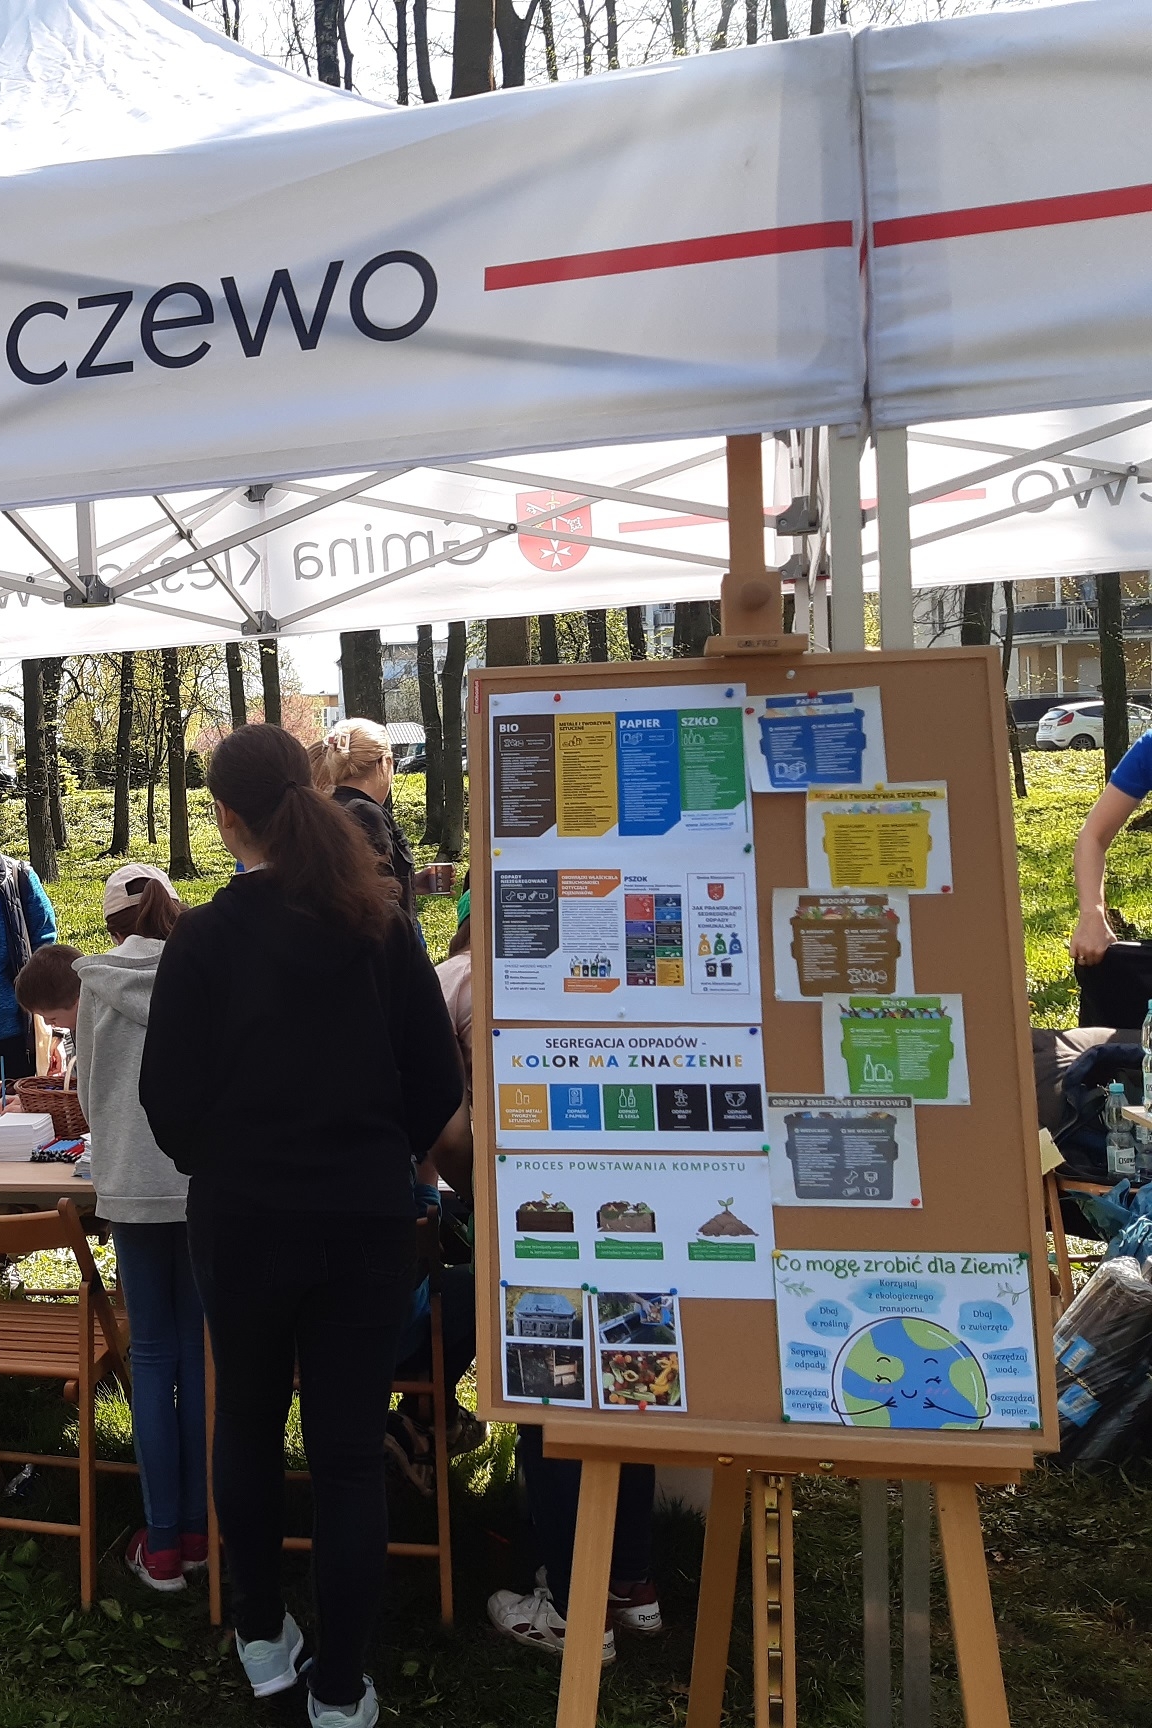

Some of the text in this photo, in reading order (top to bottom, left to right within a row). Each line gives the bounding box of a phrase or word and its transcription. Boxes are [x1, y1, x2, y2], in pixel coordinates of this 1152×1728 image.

[620, 718, 660, 729] PAPIER
[681, 716, 718, 727] SZKŁO
[499, 724, 519, 732] BIO
[545, 1038, 625, 1049] SEGREGACJA
[628, 1034, 698, 1048] ODPADÓW
[511, 1055, 743, 1068] KOLOR MA ZNACZENIE
[853, 1099, 908, 1107] (RESZTKOWE)
[516, 1161, 746, 1172] PROCES POWSTAWANIA KOMPOSTU
[776, 1254, 1025, 1279] Co mogę zrobić dla Ziemi?
[879, 1279, 918, 1290] Korzystaj
[875, 1292, 934, 1302] ekologicznego
[820, 1307, 838, 1317] Dbaj
[879, 1305, 924, 1314] transportu.
[973, 1310, 993, 1319] Dbaj
[820, 1319, 850, 1330] rośliny.
[968, 1322, 1010, 1332] zwierzęta.
[791, 1348, 827, 1359] Segreguj
[982, 1352, 1028, 1363] Oszczędzaj
[795, 1361, 828, 1371] odpady.
[995, 1365, 1020, 1375] wodę.
[785, 1388, 829, 1398] Oszczędzaj
[990, 1393, 1036, 1404] Oszczędzaj
[791, 1401, 825, 1411] energię.
[1001, 1407, 1030, 1416] papier.
